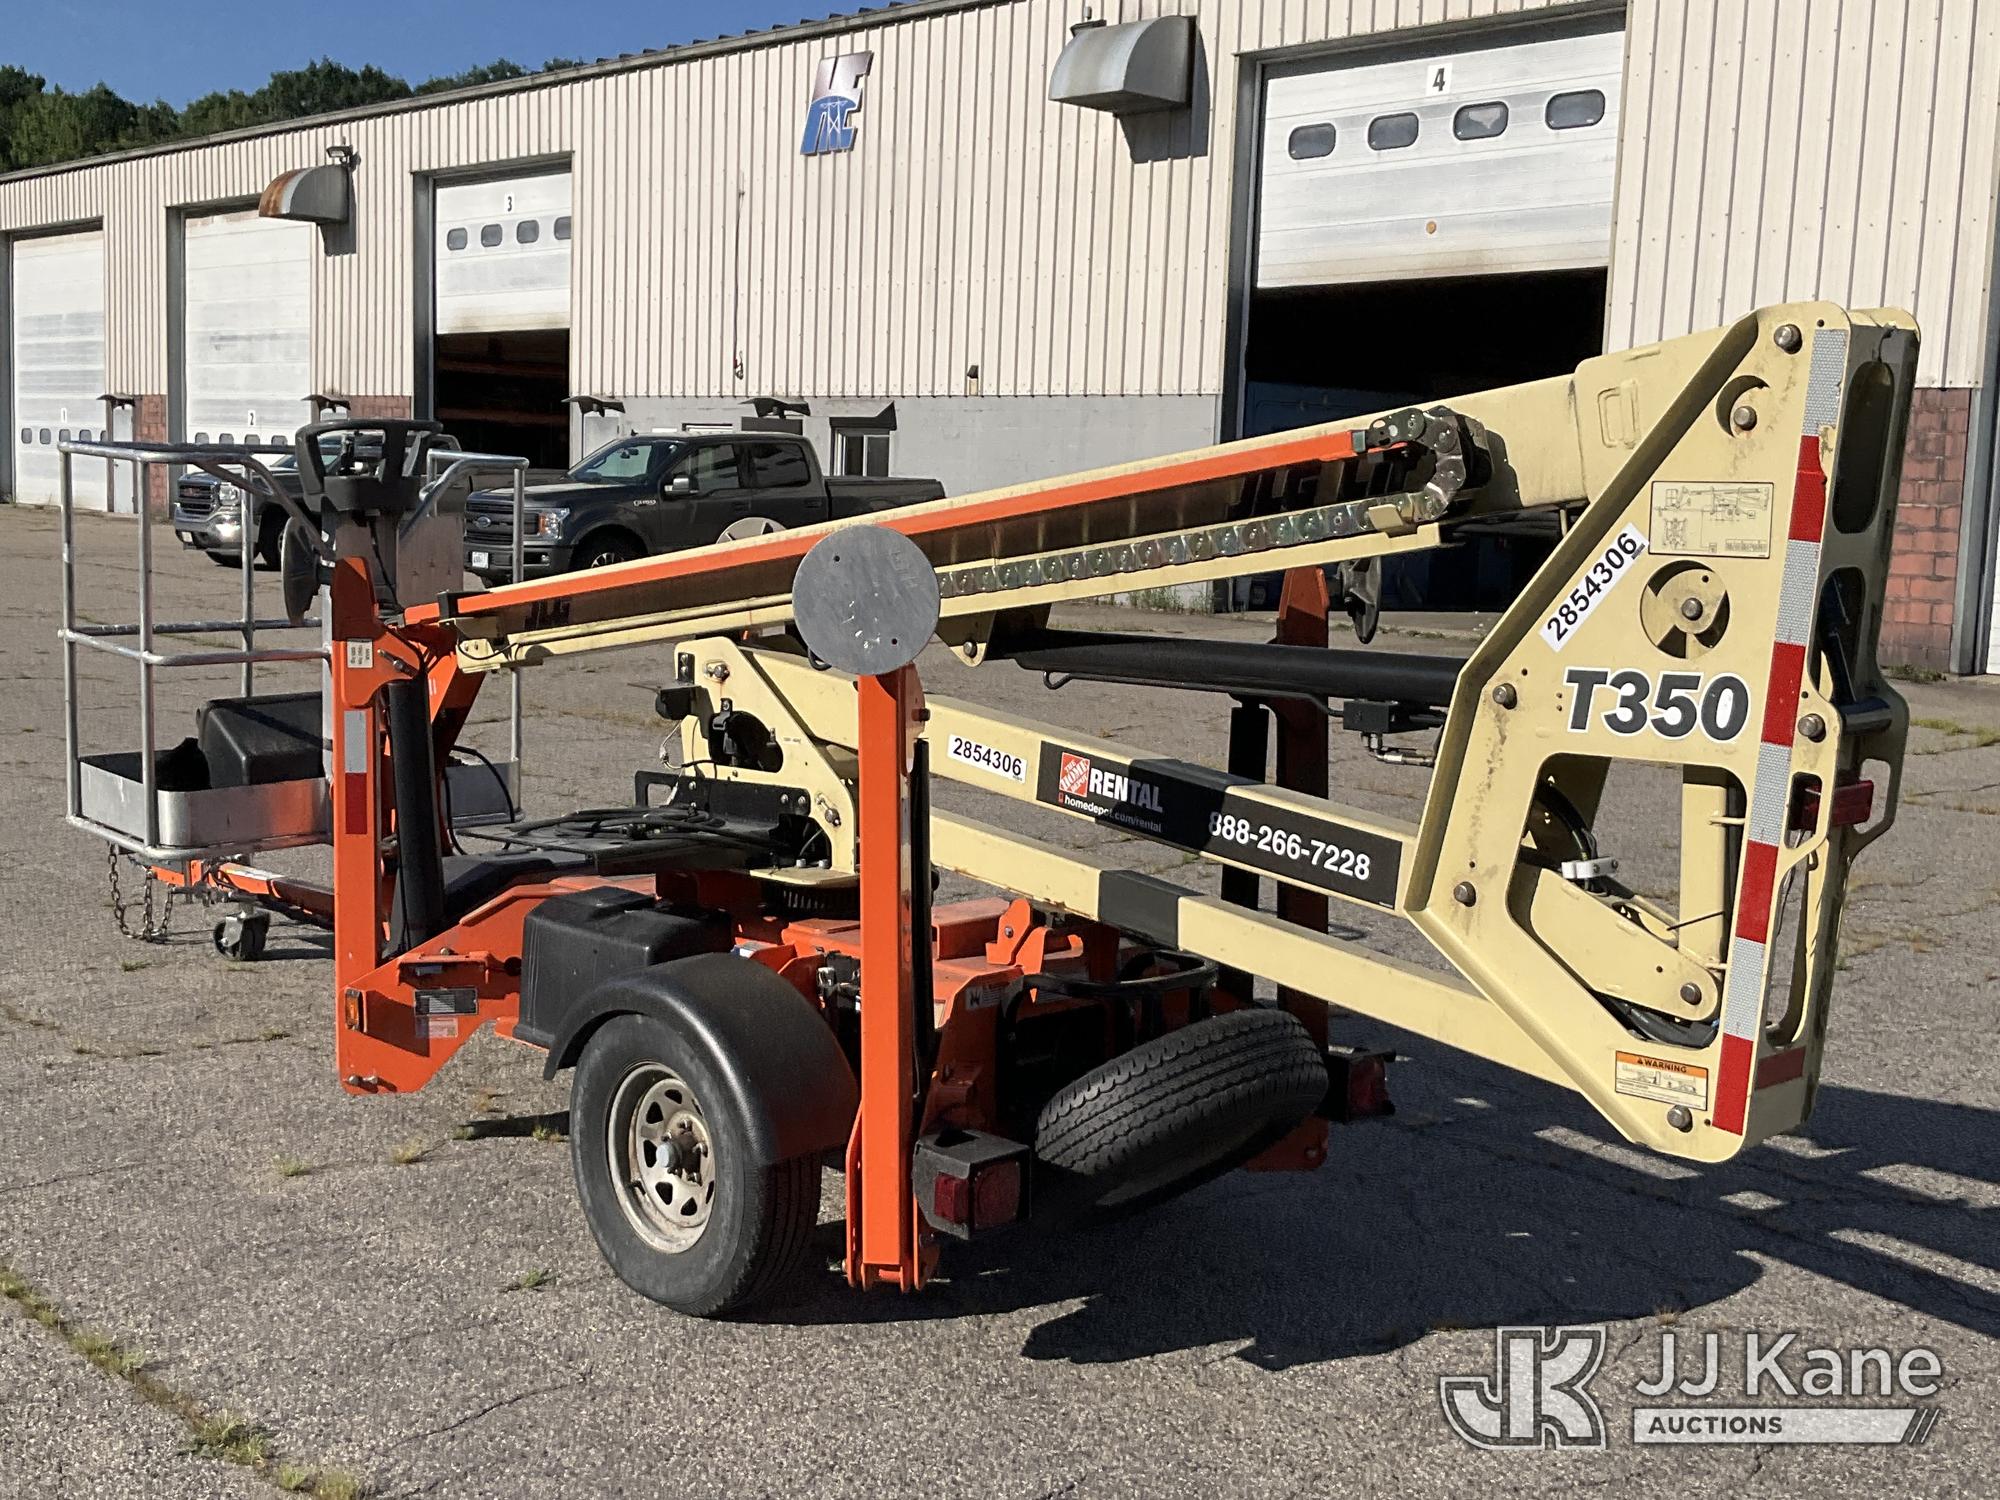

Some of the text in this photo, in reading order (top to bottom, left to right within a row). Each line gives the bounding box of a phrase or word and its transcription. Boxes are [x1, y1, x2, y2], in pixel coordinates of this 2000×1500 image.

[1432, 67, 1446, 92] 4
[1547, 532, 1637, 642] 2854306
[1564, 667, 1750, 743] T350
[953, 737, 1022, 776] 2854306
[1060, 760, 1089, 791] HOME
[1089, 767, 1163, 813] RENTAL
[1208, 811, 1371, 881] 888-266-7228
[1644, 1058, 1687, 1074] WARNING
